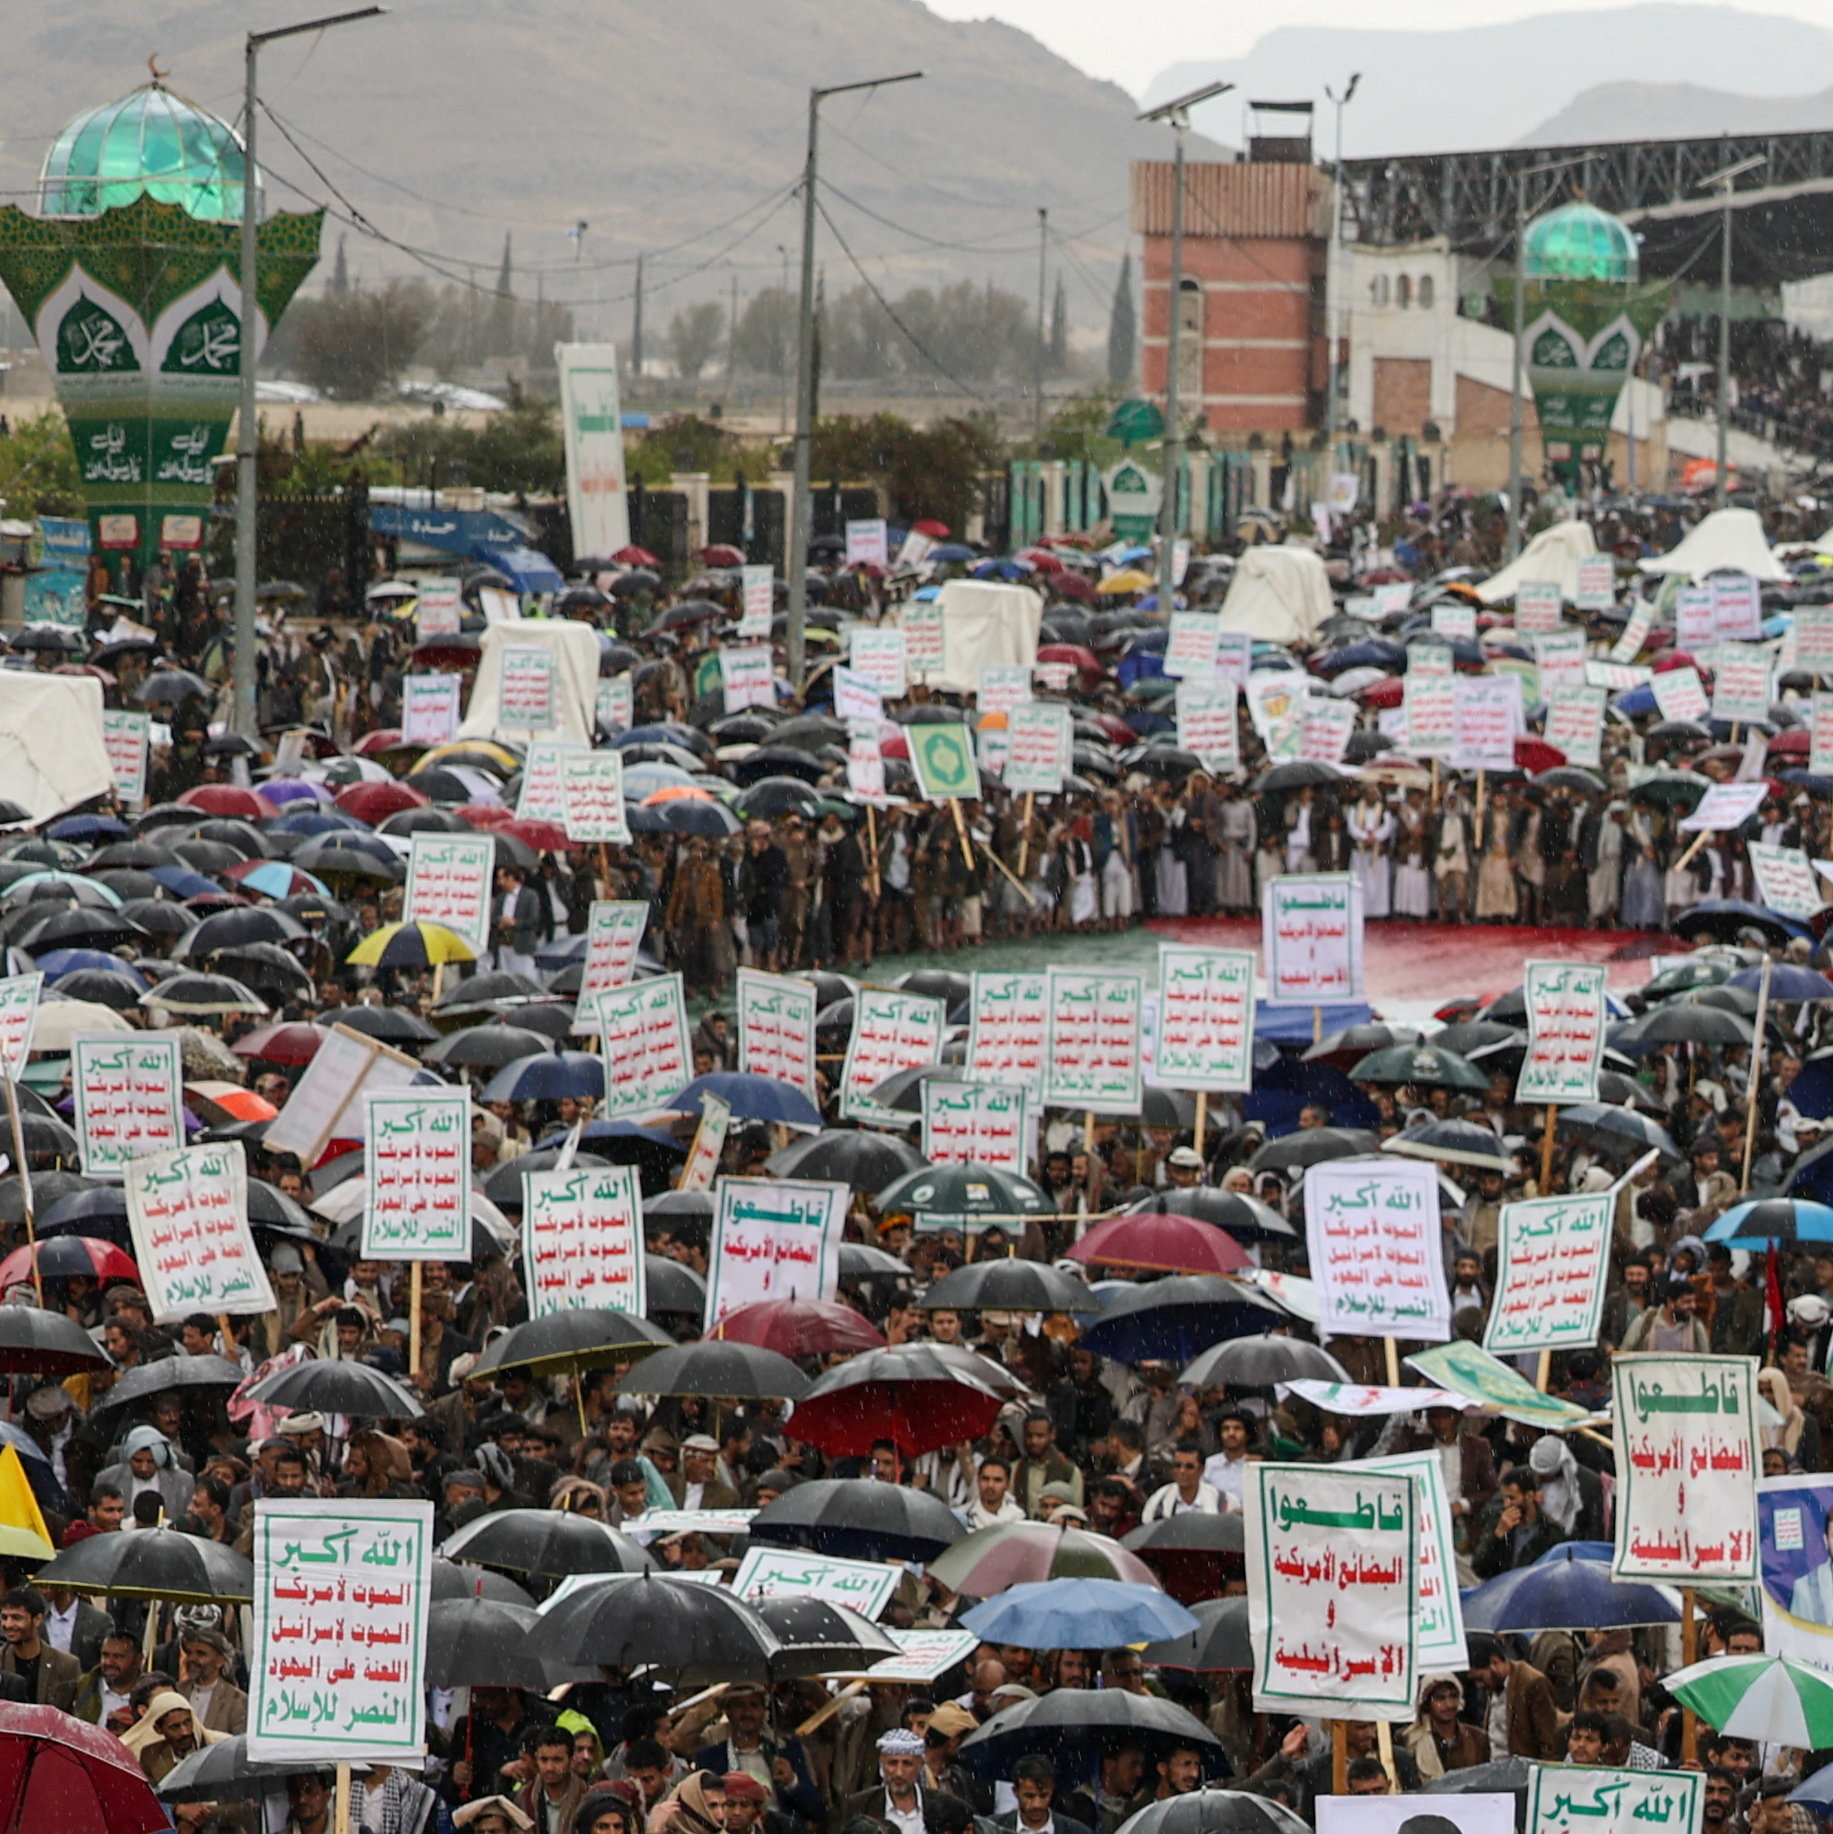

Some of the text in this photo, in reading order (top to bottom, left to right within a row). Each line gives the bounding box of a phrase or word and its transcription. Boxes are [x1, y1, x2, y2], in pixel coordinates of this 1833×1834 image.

[1631, 1371, 1739, 1424] قاطعوا
[1629, 1434, 1750, 1478] البضائع الأمريكية
[1270, 1488, 1404, 1531] قاطعوا
[1676, 1483, 1687, 1515] و
[275, 1524, 414, 1572] الله أكبر
[1273, 1545, 1404, 1590] البضائع الأمريكية
[1628, 1527, 1753, 1572] الإسرائيلية
[272, 1576, 410, 1608] الموت لأمريكا
[270, 1616, 410, 1648] الموت لإسرائيل
[1326, 1602, 1337, 1628] و
[268, 1658, 405, 1685] اللعنة على اليهود
[1274, 1643, 1405, 1682] الإسرائيلية
[266, 1690, 406, 1731] النصر للإسلام
